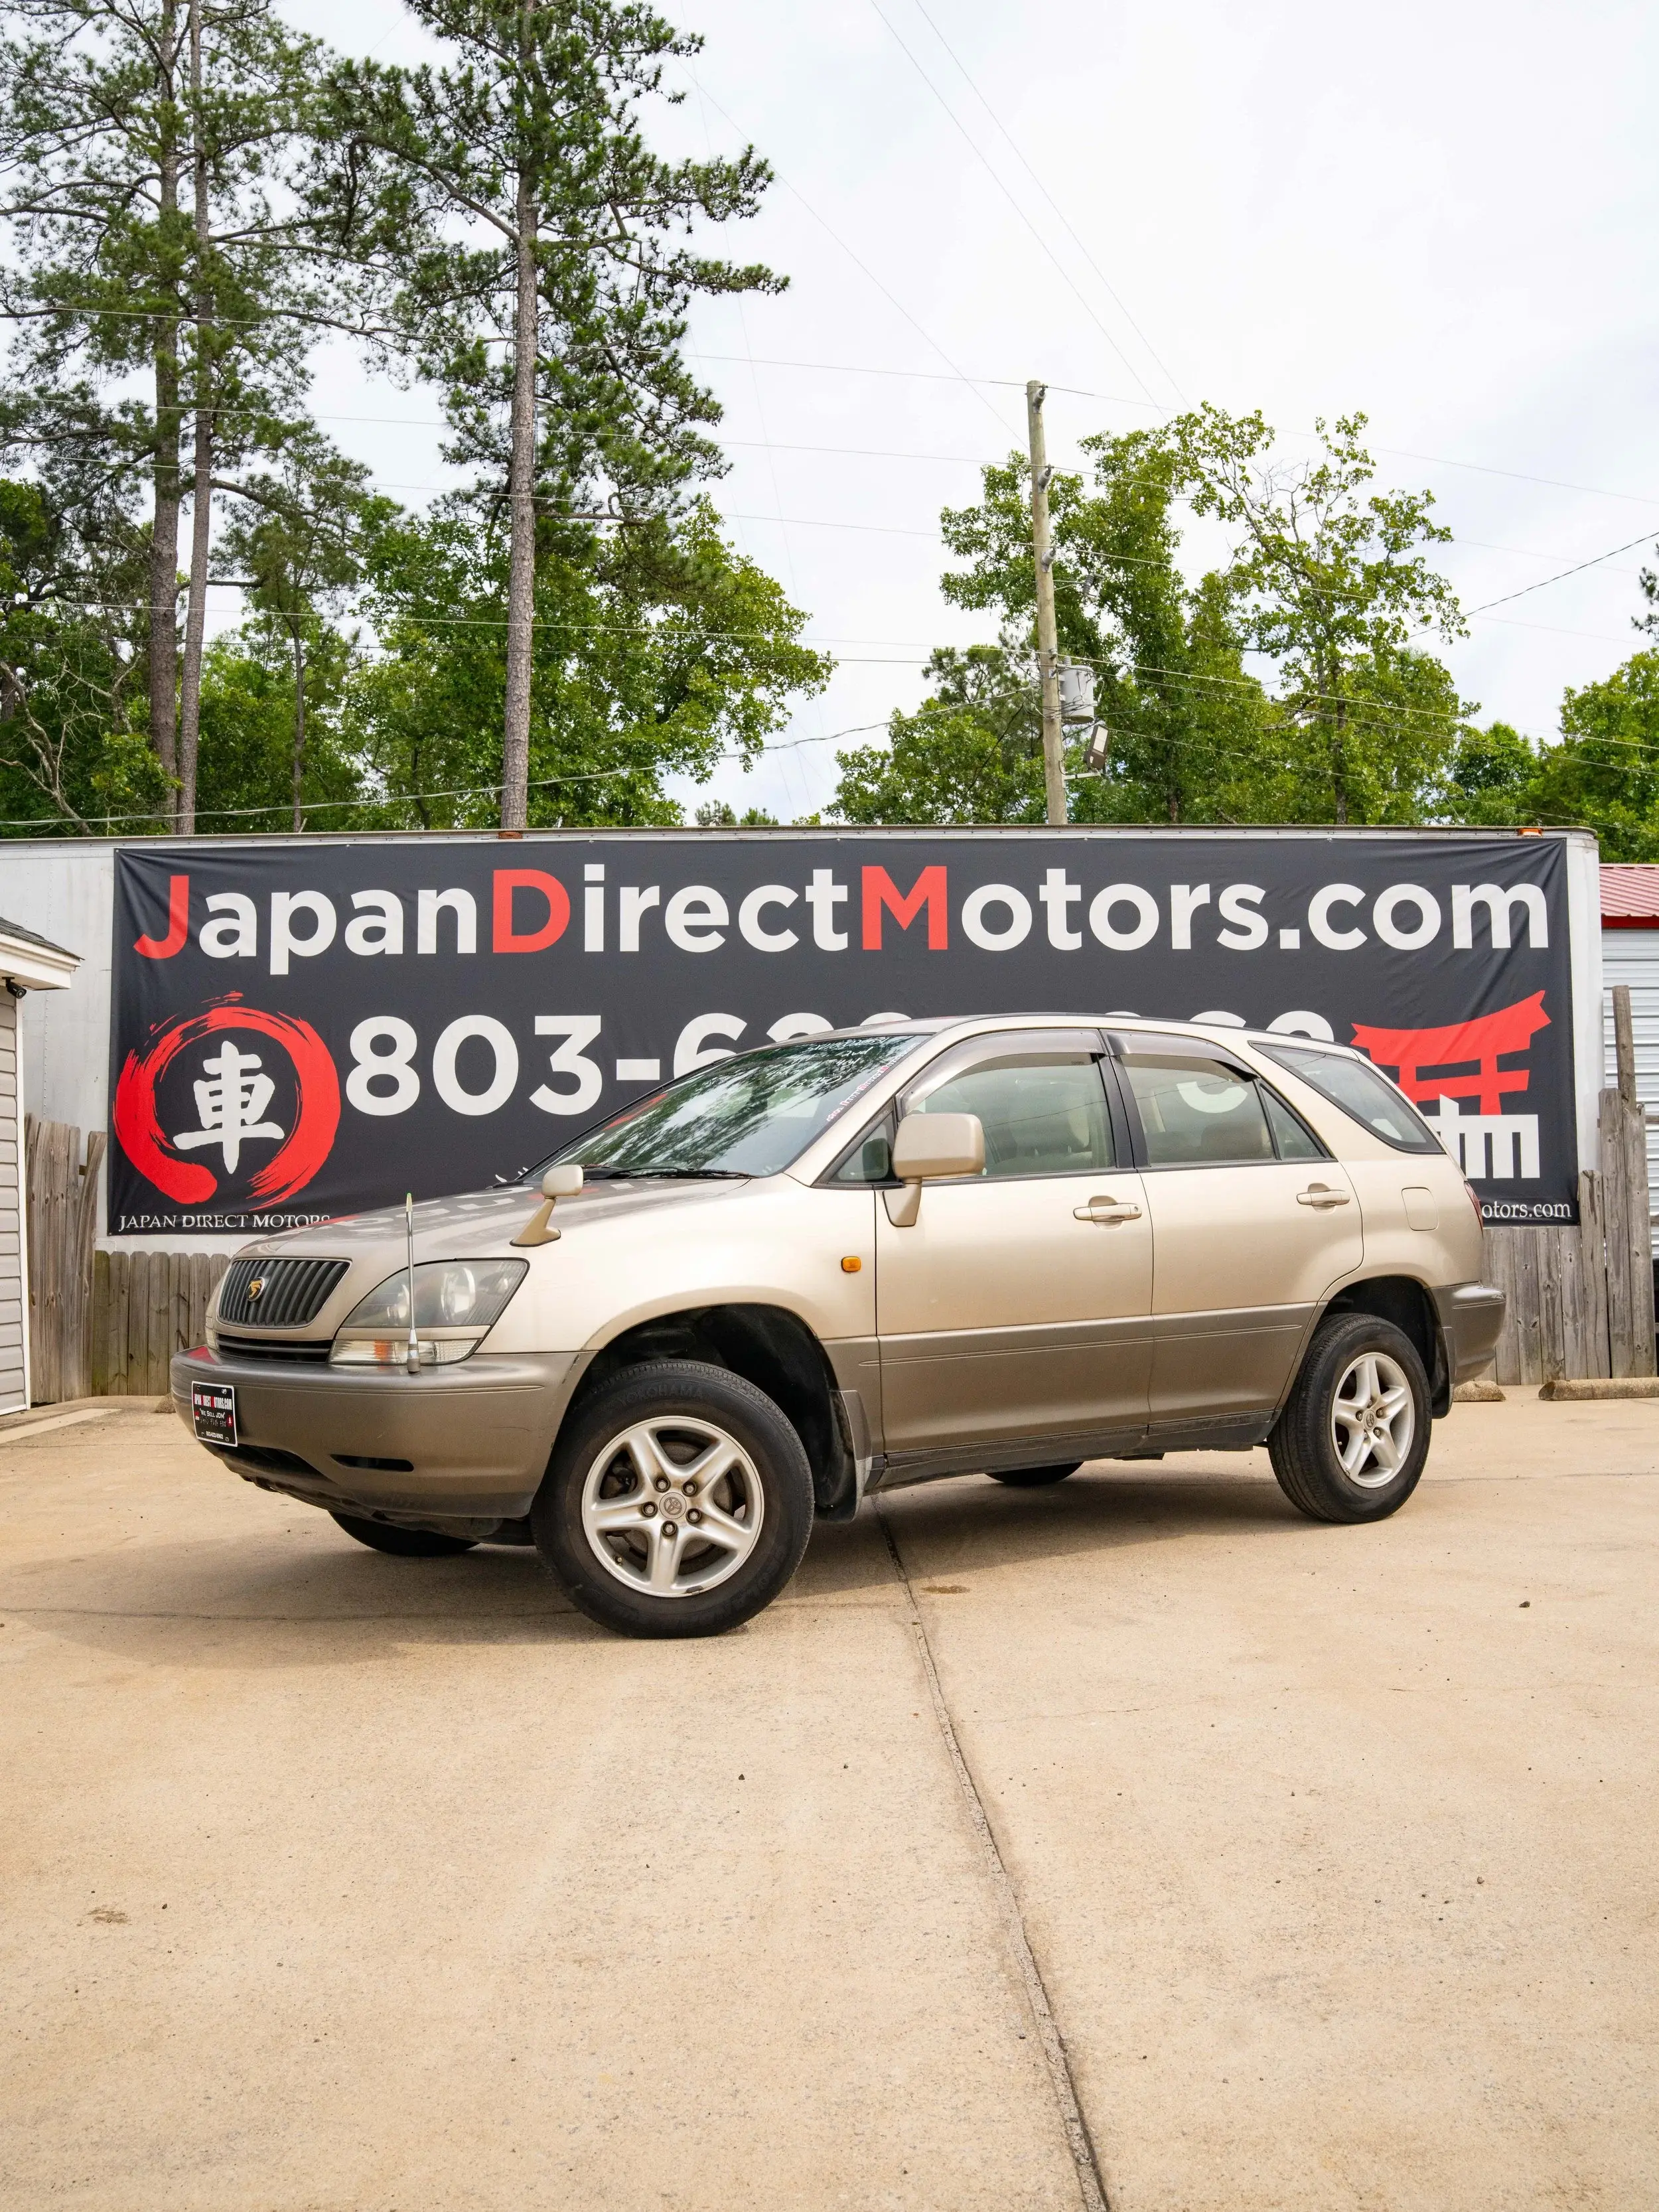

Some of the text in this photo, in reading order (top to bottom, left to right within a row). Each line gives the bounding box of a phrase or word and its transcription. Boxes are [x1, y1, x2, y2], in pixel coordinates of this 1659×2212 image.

[133, 863, 1549, 975] JapanDirectMotors.com
[173, 1040, 285, 1174] 車
[118, 1215, 177, 1232] JAPAN
[182, 1214, 249, 1228] DIRECT
[1482, 1200, 1572, 1218] otors.com
